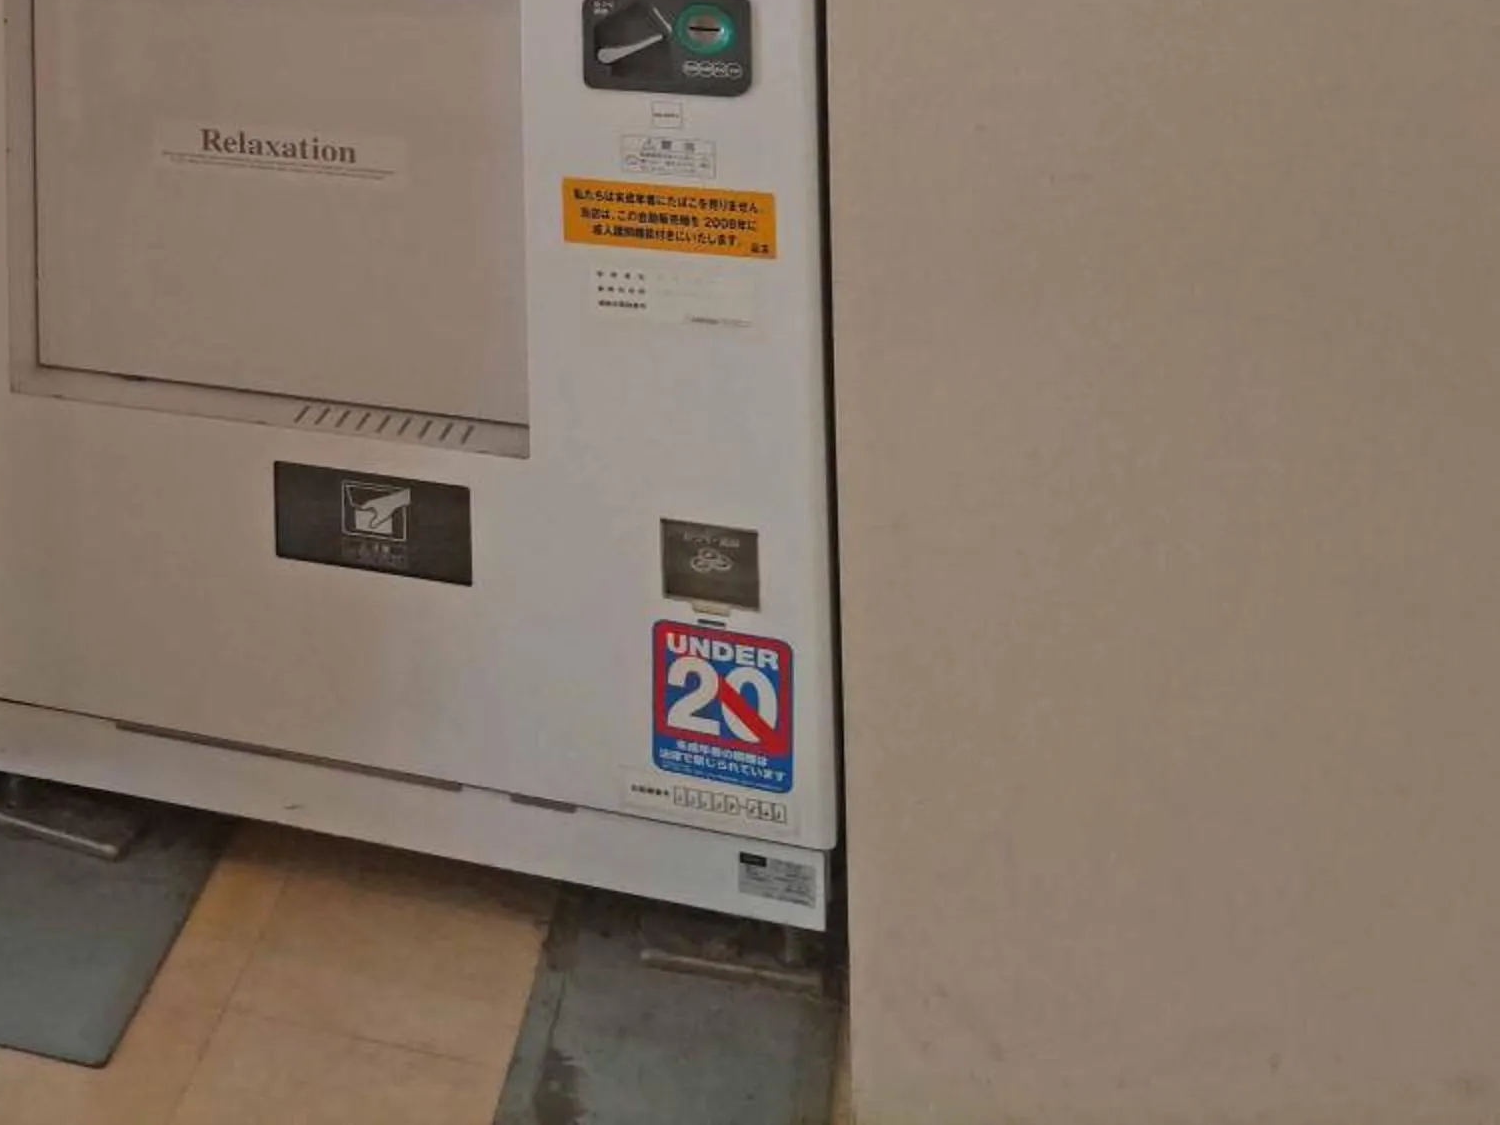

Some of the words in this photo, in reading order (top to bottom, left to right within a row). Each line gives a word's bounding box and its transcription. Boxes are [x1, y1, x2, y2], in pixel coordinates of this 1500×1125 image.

[200, 127, 357, 164] Relaxation
[665, 632, 780, 670] UNDER
[667, 656, 778, 744] 20
